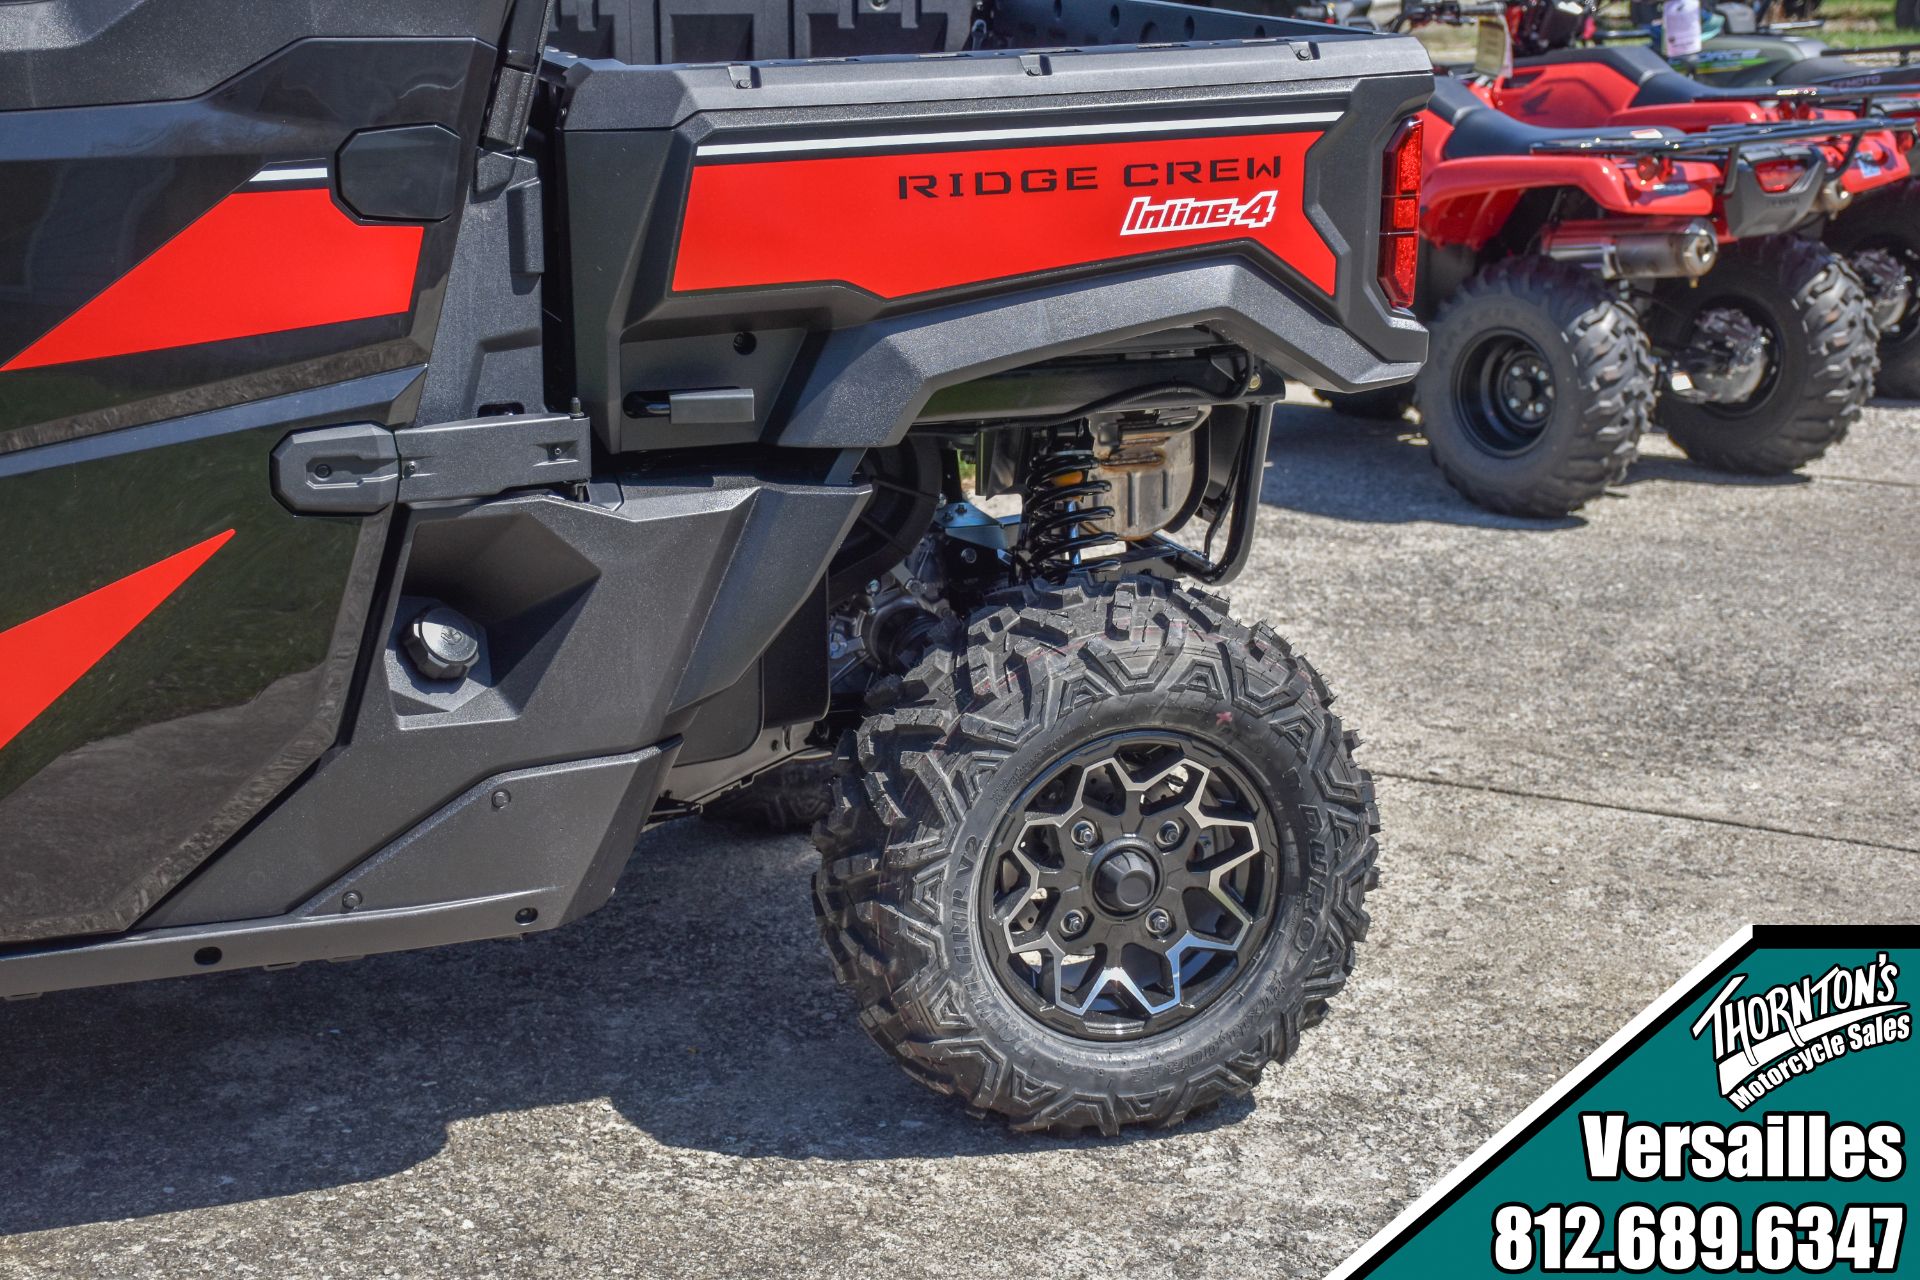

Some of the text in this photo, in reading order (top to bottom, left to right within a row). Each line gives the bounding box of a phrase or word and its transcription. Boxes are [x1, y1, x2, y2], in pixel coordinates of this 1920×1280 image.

[898, 155, 1281, 200] RIDGE CREW
[1119, 190, 1279, 236] Inline-4
